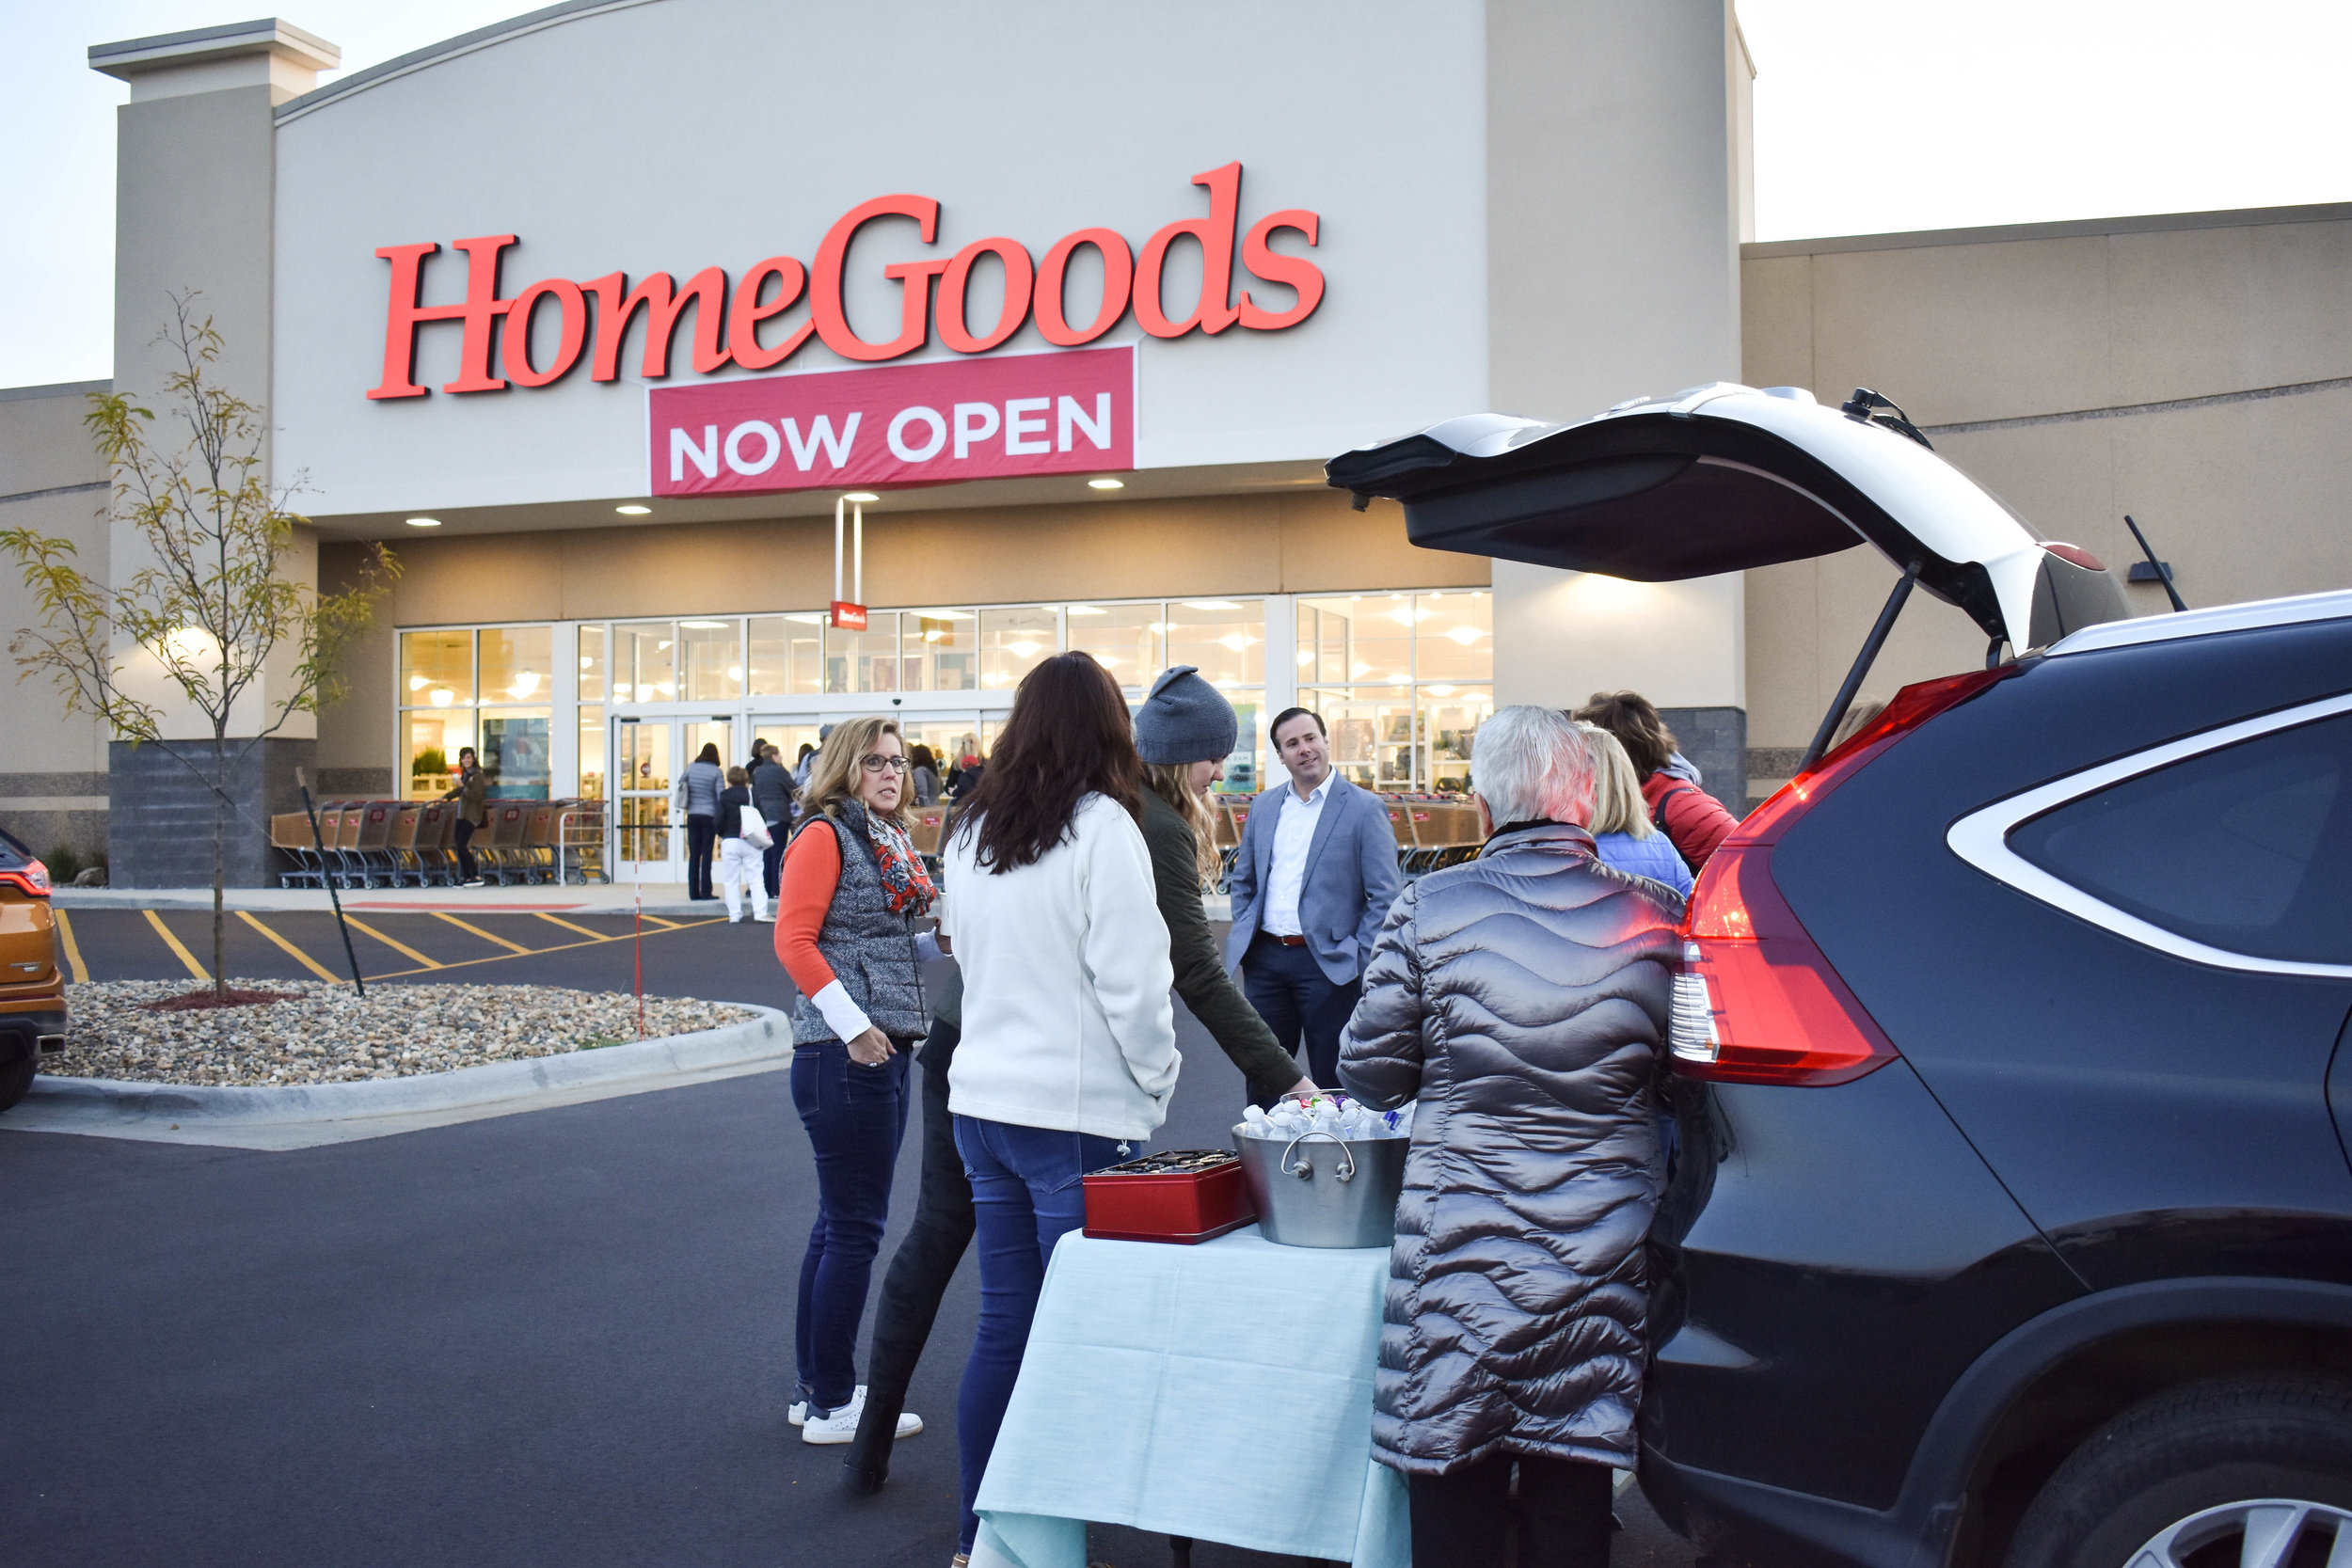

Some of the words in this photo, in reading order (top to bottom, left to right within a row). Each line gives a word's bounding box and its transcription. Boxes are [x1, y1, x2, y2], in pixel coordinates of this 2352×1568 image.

[366, 161, 1325, 401] HomeGoods
[670, 412, 863, 483] NOW
[886, 392, 1112, 463] OPEN
